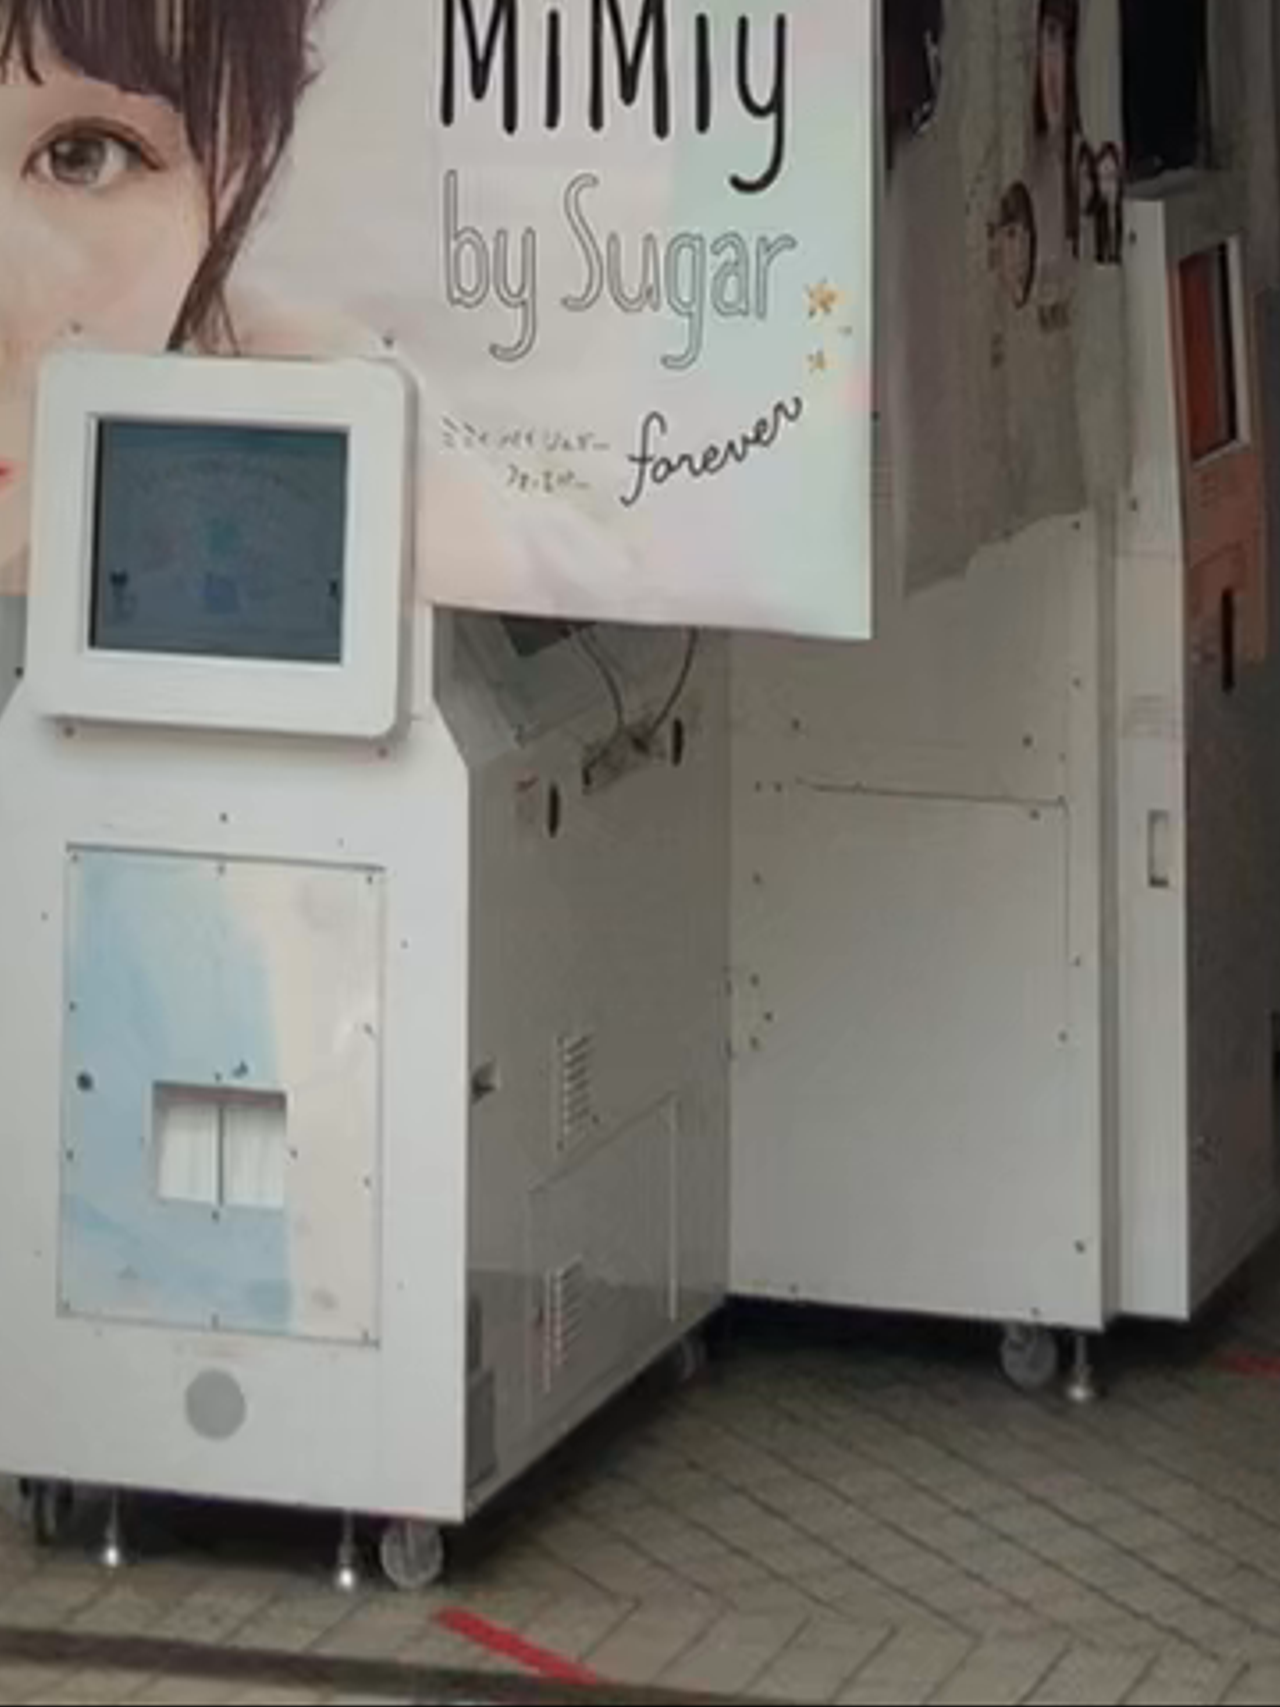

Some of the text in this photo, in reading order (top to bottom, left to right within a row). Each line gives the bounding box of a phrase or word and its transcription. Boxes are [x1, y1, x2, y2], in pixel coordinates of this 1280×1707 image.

[443, 170, 796, 370] by Sugar
[620, 395, 803, 505] forever
